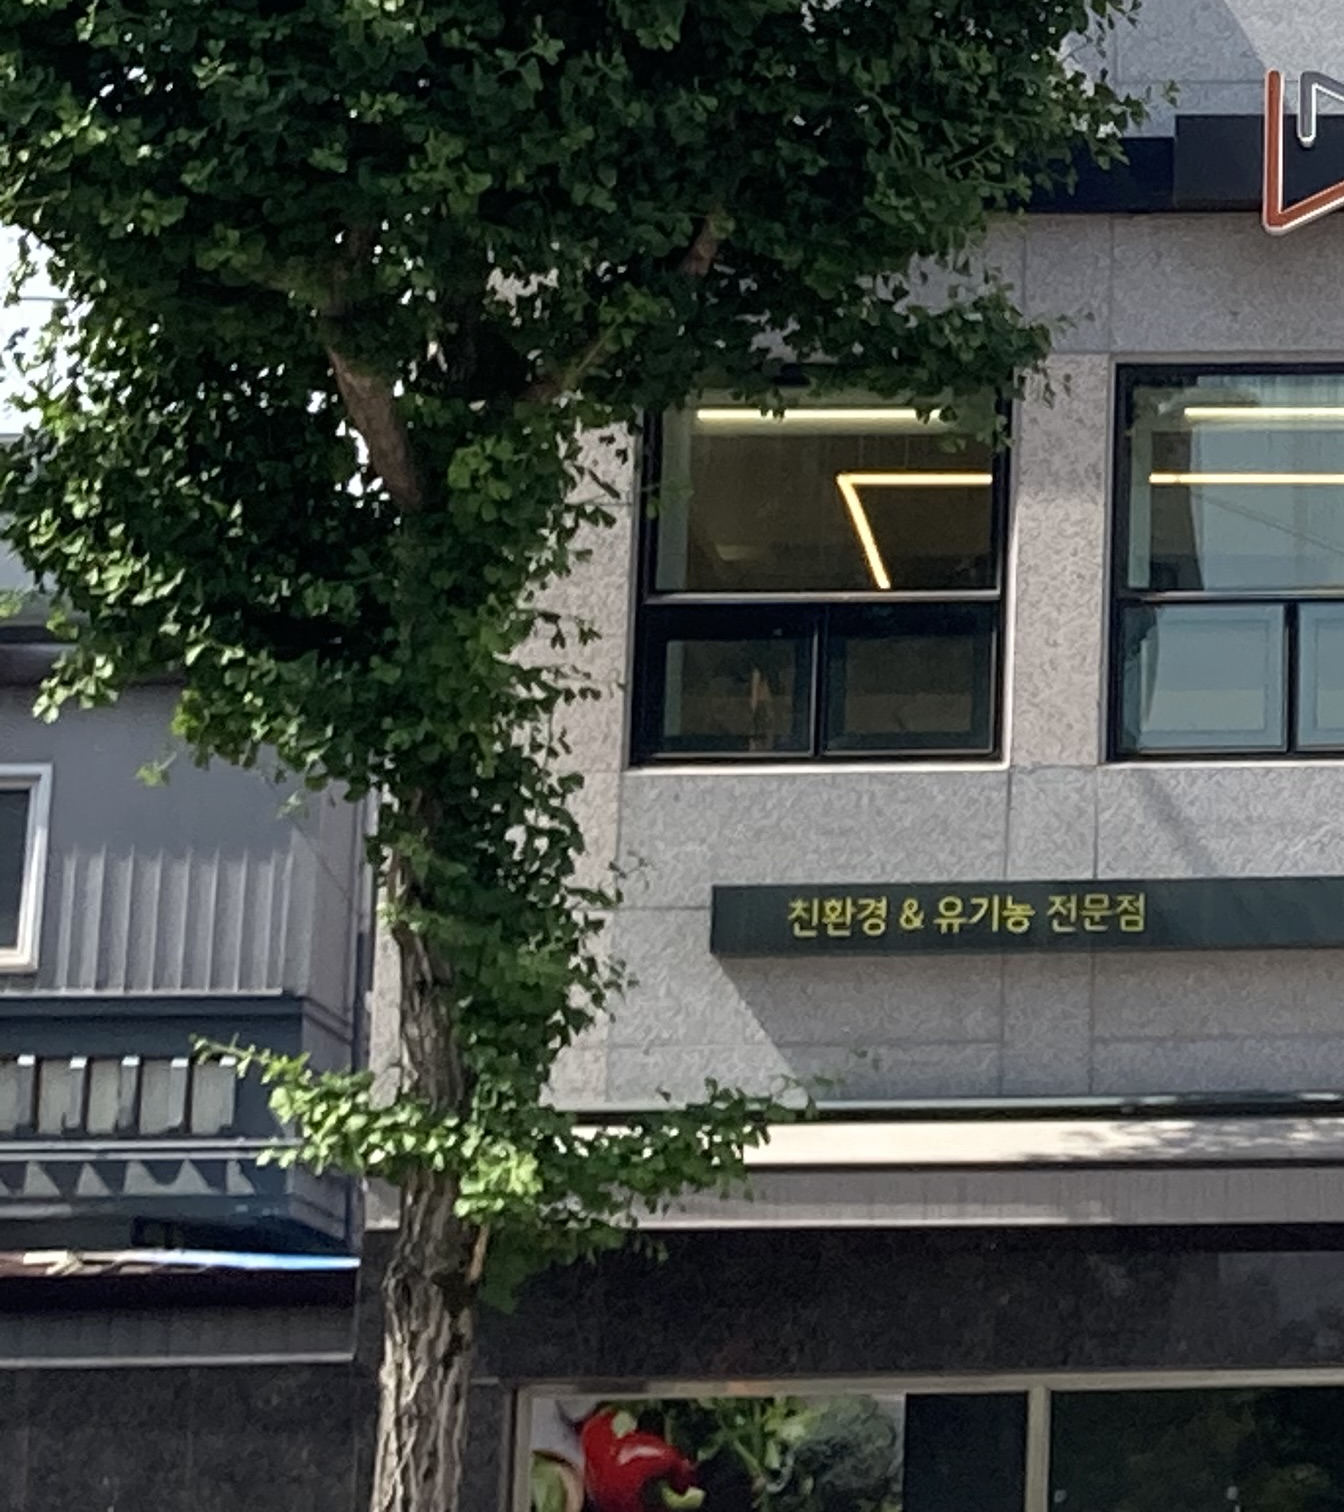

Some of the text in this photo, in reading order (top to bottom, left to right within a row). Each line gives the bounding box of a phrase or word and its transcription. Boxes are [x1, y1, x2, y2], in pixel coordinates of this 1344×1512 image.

[787, 892, 1147, 938] 친환경 & 유기농 전문점
